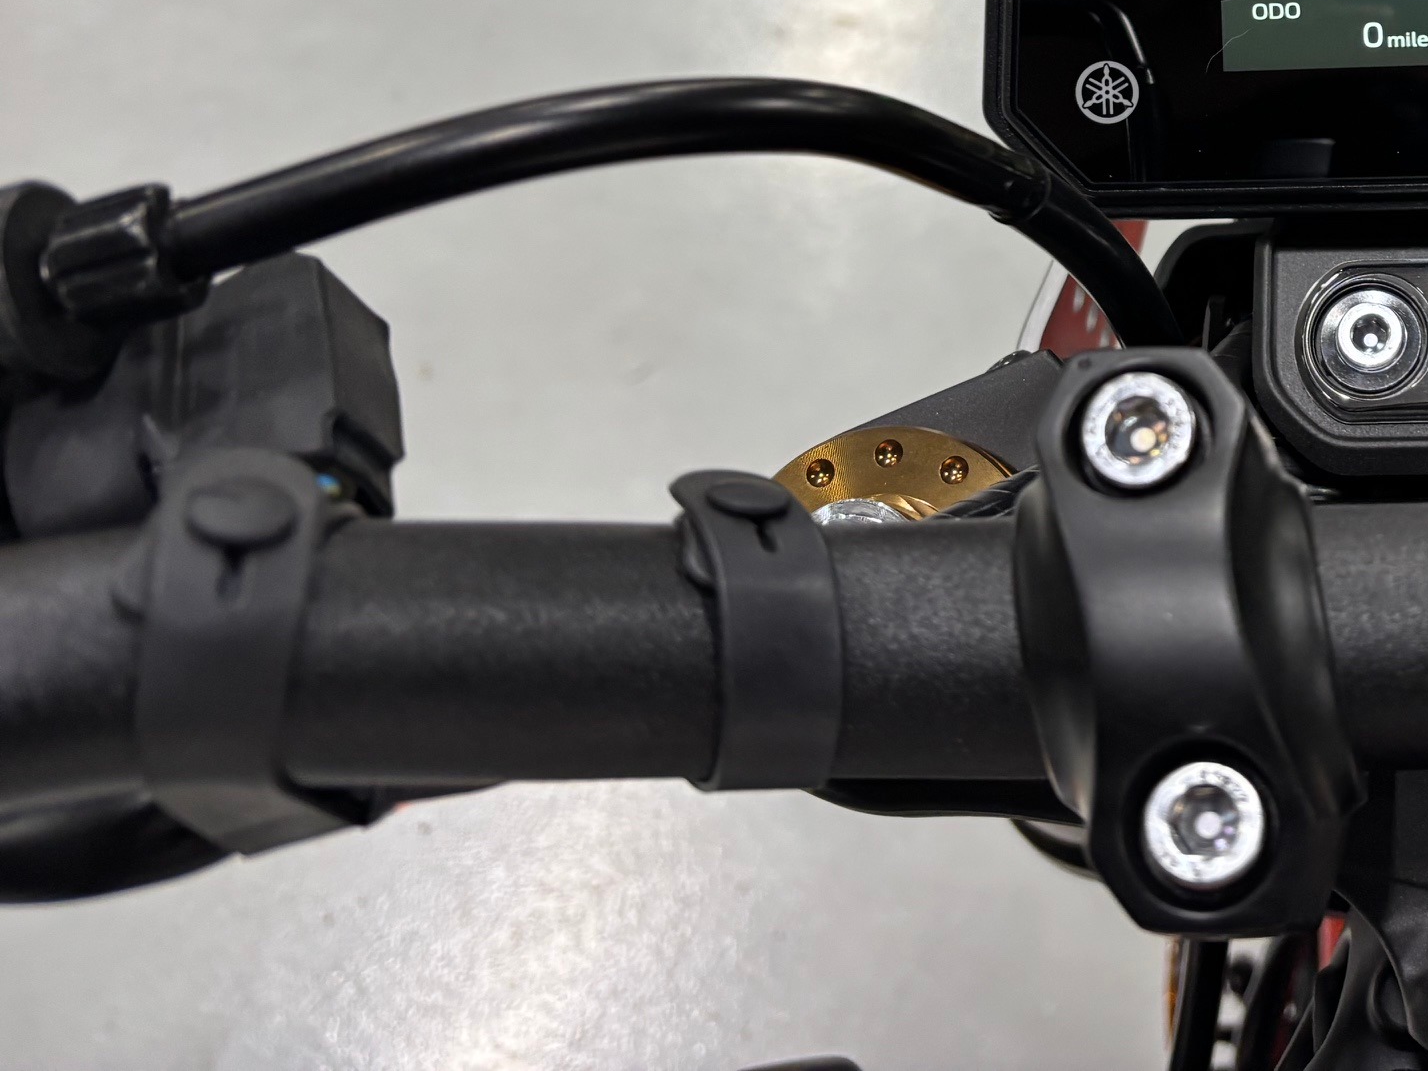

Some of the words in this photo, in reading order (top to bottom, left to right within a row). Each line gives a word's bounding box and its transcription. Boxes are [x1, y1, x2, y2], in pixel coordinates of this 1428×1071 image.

[1251, 1, 1301, 20] ODO
[1362, 21, 1384, 48] 0
[1387, 30, 1428, 48] mile
